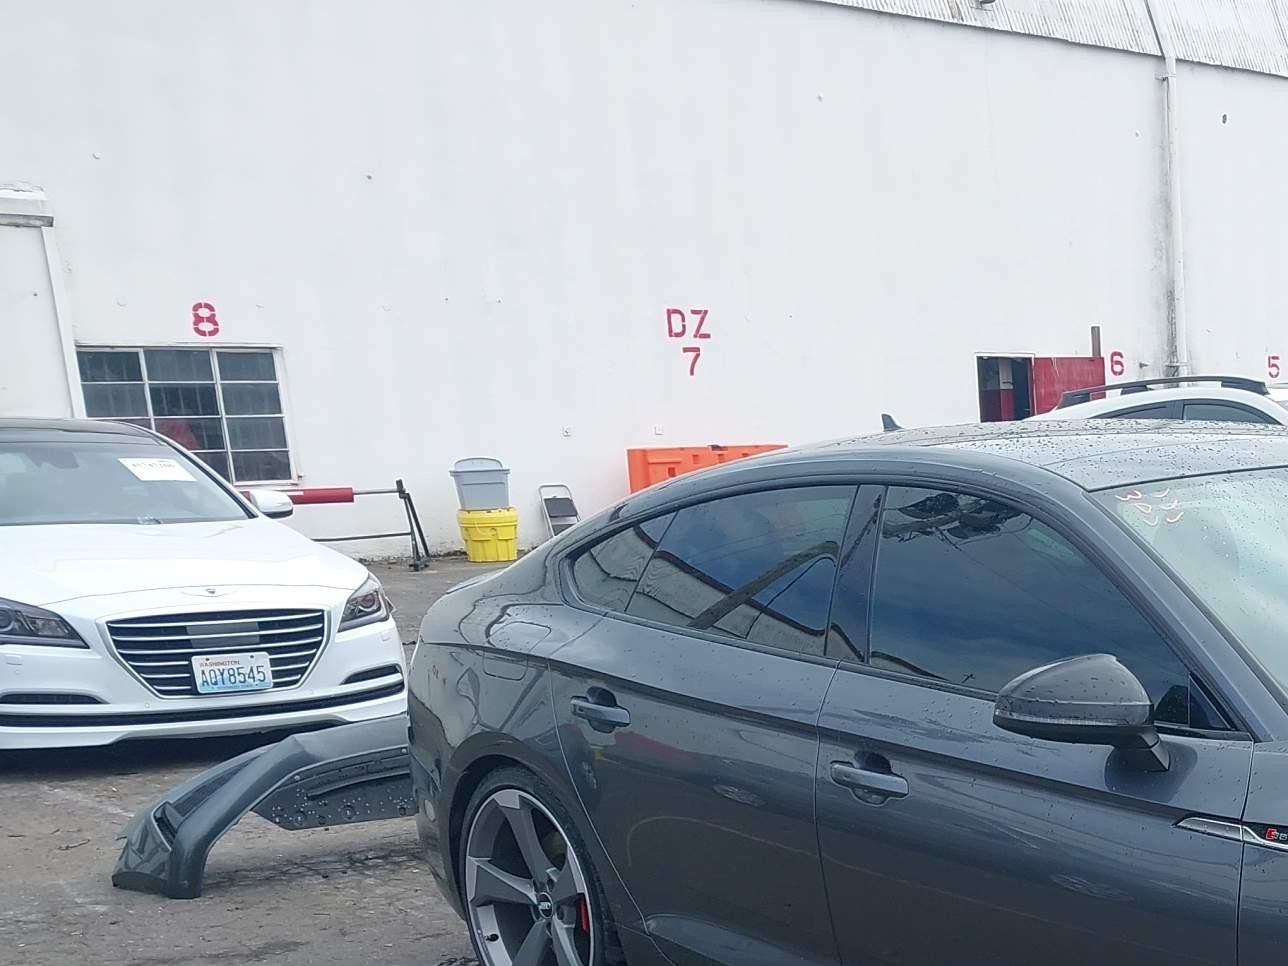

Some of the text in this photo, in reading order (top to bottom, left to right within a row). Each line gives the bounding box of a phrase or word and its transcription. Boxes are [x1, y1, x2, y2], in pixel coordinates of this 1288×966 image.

[192, 302, 220, 337] 8
[666, 308, 711, 339] DZ
[682, 346, 701, 377] 7
[1110, 351, 1124, 377] 6
[1268, 356, 1280, 379] 5
[201, 665, 266, 687] AQY8545
